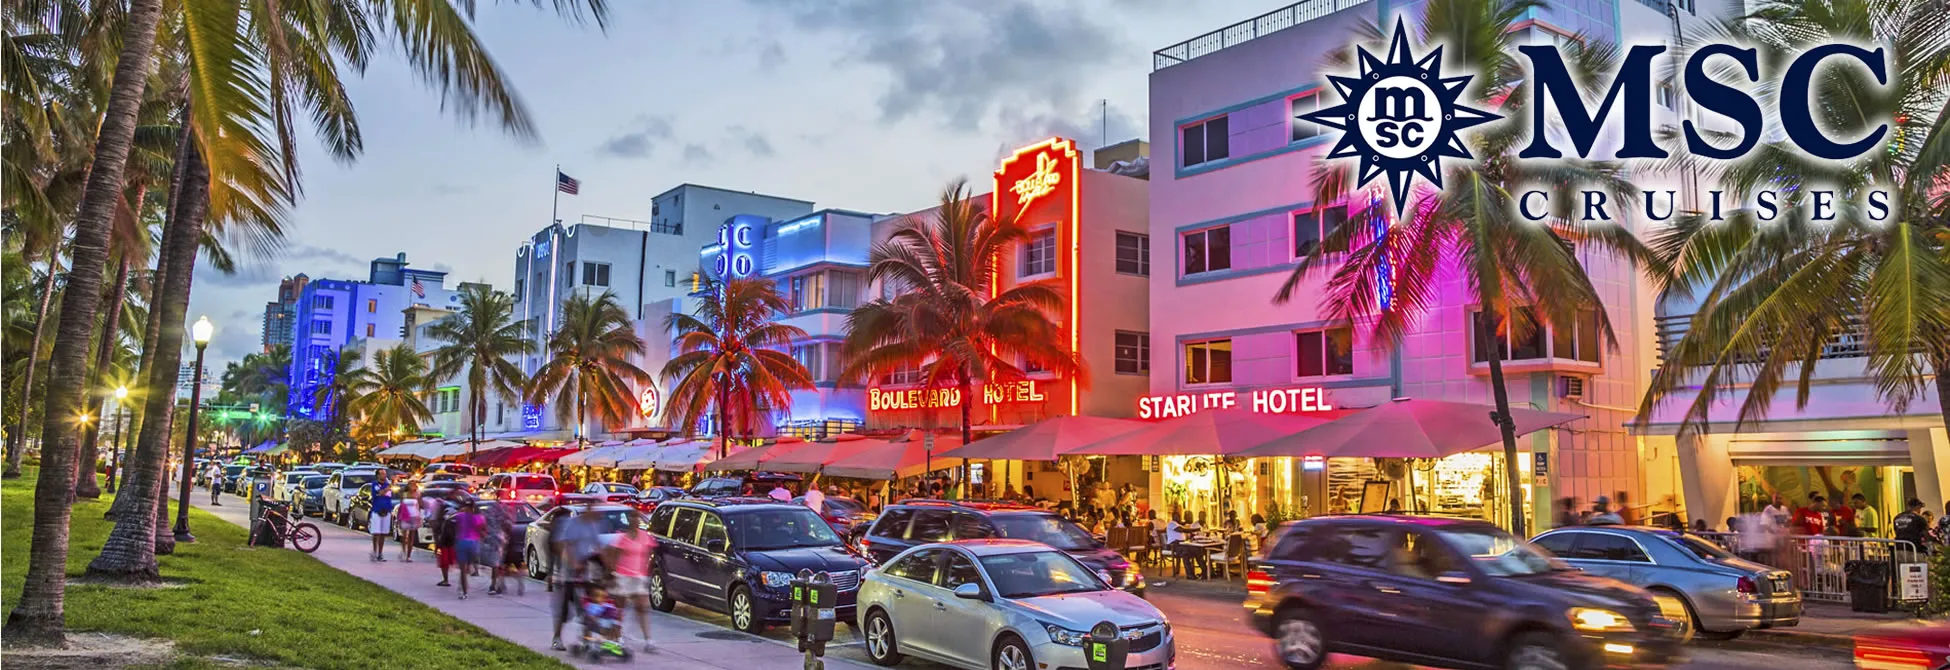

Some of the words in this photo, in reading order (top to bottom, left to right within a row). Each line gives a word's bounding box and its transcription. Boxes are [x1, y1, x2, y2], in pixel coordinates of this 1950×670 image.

[869, 387, 961, 411] BOULEVARD
[983, 380, 1044, 404] HOTEL
[1252, 387, 1332, 414] HOTEL
[1139, 391, 1236, 419] STARLITE
